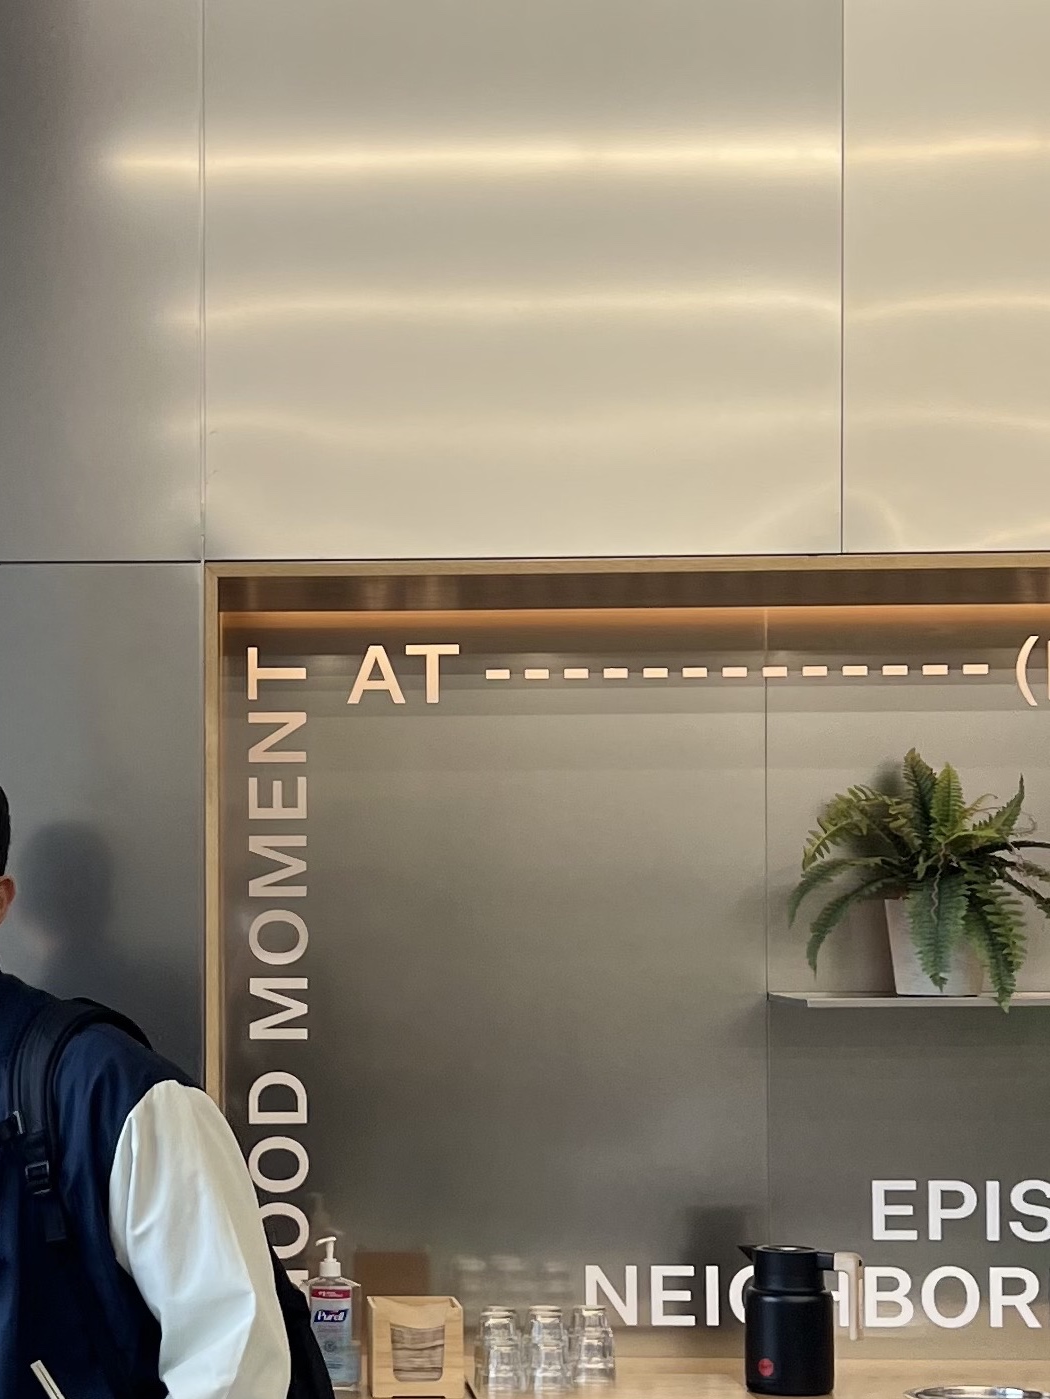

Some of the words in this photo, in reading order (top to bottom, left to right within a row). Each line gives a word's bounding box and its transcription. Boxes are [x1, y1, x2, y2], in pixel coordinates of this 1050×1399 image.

[347, 643, 460, 704] AT
[246, 645, 309, 1042] MOMENT
[247, 1070, 310, 1304] OOD
